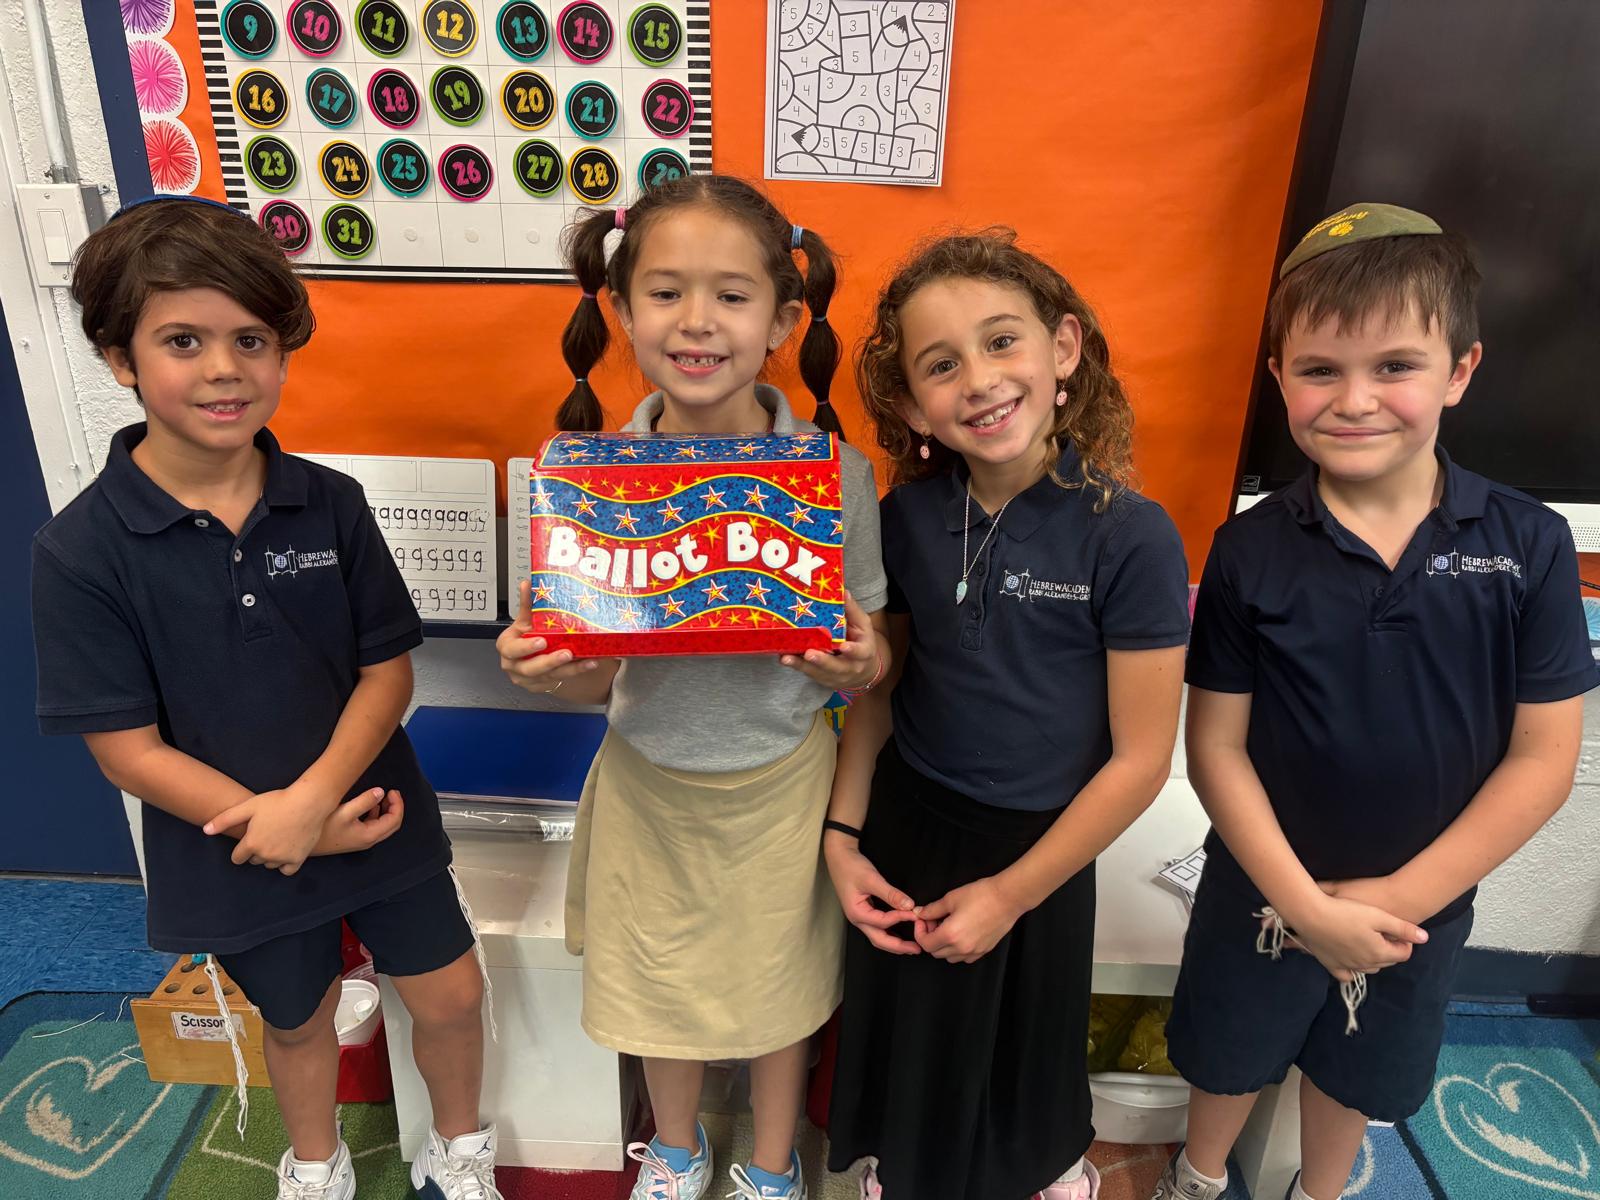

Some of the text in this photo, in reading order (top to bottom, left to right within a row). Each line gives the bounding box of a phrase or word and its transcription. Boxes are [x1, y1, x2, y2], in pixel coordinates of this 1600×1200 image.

[790, 7, 798, 20] 5
[816, 3, 823, 16] 2
[871, 3, 879, 16] 4
[890, 5, 898, 18] 4
[927, 4, 935, 17] 2
[244, 9, 669, 49] 9 10 11 12 13 14 15
[807, 22, 814, 35] 5
[849, 20, 857, 32] 3
[787, 34, 795, 47] 2
[826, 29, 834, 42] 4
[932, 32, 940, 44] 3
[801, 56, 808, 69] 4
[852, 51, 859, 63] 5
[913, 50, 921, 62] 4
[832, 59, 839, 71] 3
[931, 64, 939, 77] 2
[781, 79, 789, 91] 4
[826, 77, 834, 89] 3
[901, 74, 908, 87] 4
[803, 84, 810, 96] 4
[860, 84, 867, 97] 2
[883, 84, 891, 97] 3
[249, 81, 681, 124] 16 17 18 19 20 21 22
[924, 102, 932, 115] 3
[793, 104, 800, 117] 4
[900, 108, 908, 121] 4
[857, 115, 865, 127] 3
[822, 136, 830, 148] 5
[840, 136, 848, 148] 5
[860, 142, 868, 154] 5
[879, 142, 886, 155] 5
[896, 146, 904, 158] 3
[259, 151, 286, 176] 23
[332, 156, 360, 182] 24
[392, 154, 417, 180] 25
[452, 159, 481, 186] 26
[527, 155, 553, 180] 27
[581, 162, 609, 188] 28
[272, 215, 361, 245] 30 31
[546, 525, 708, 588] Ballot
[726, 521, 826, 587] Box
[181, 1015, 226, 1028] Scissor
